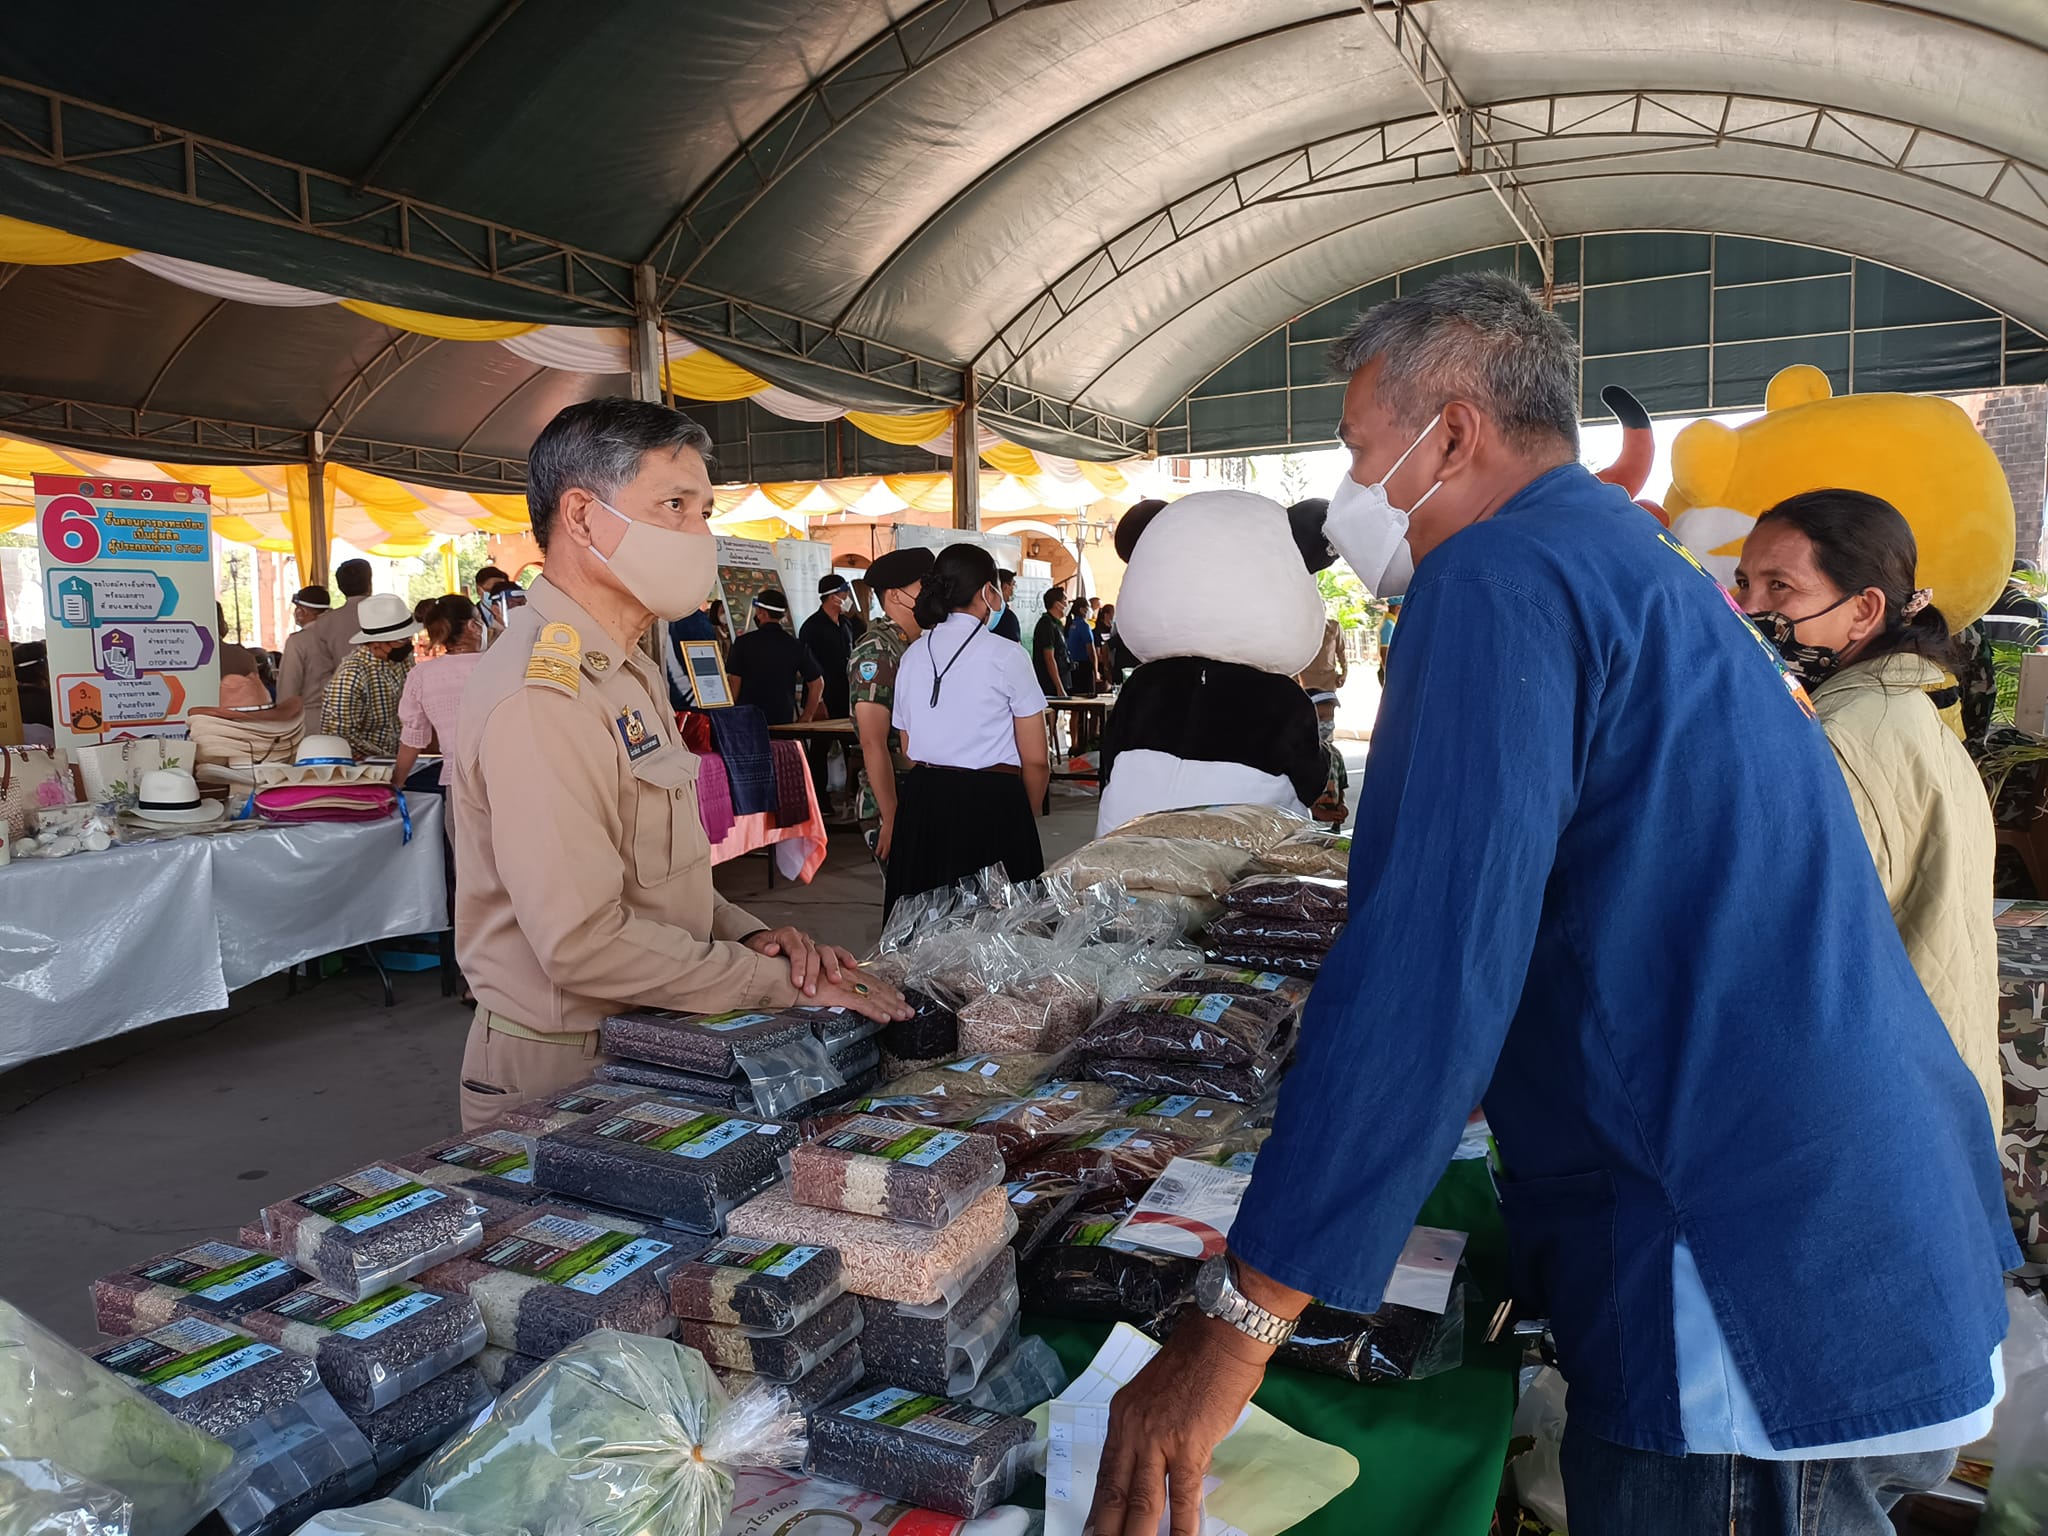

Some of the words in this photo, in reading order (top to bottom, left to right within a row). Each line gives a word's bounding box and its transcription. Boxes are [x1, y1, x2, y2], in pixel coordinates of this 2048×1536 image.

[104, 511, 205, 530] ขั้นตอนการลงทะเบียน
[42, 495, 101, 564] 6
[133, 528, 179, 543] เป็นผู้ผลิต
[108, 539, 171, 555] ผู้ประกอบการ
[175, 544, 203, 555] OTOP
[71, 580, 83, 591] 1.
[111, 633, 123, 644] 2.
[79, 688, 92, 699] 3.
